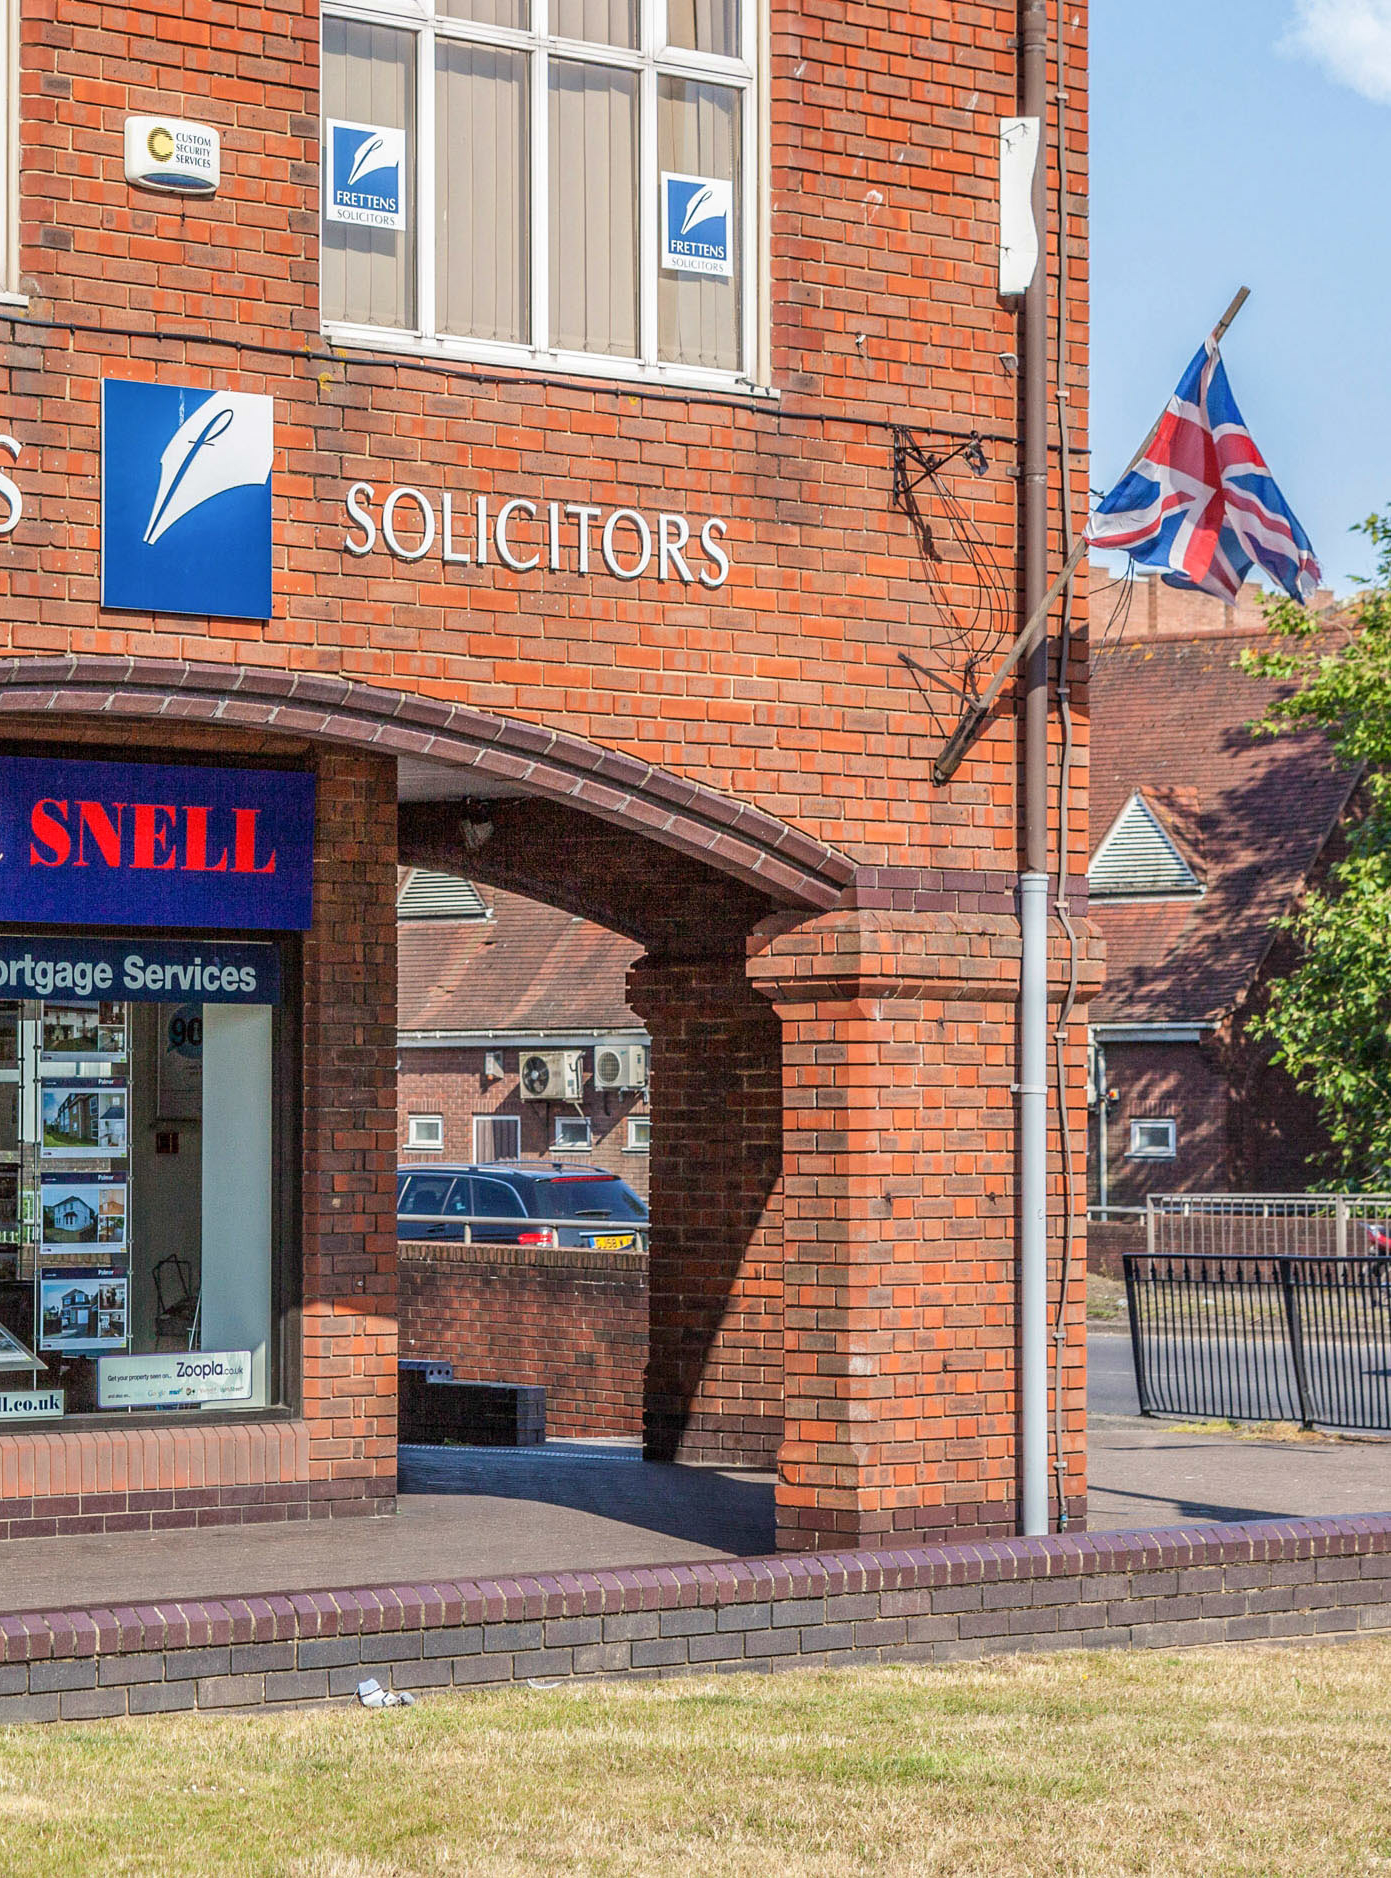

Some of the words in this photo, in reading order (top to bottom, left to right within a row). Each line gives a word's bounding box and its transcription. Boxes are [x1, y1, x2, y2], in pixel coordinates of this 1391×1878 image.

[175, 132, 212, 147] CUSTOM
[175, 143, 211, 158] SECURITY
[175, 154, 211, 169] SERVICES
[336, 190, 396, 211] FRETTENS
[337, 208, 395, 226] SOLICITORS
[670, 239, 725, 259] FRETTENS
[671, 256, 724, 273] SOLICITORS
[345, 480, 730, 589] SOLICITORS
[29, 798, 277, 874] SNELL
[123, 955, 257, 992] Services
[128, 1374, 149, 1382] property
[176, 1360, 244, 1380] Zoopla.co.uk
